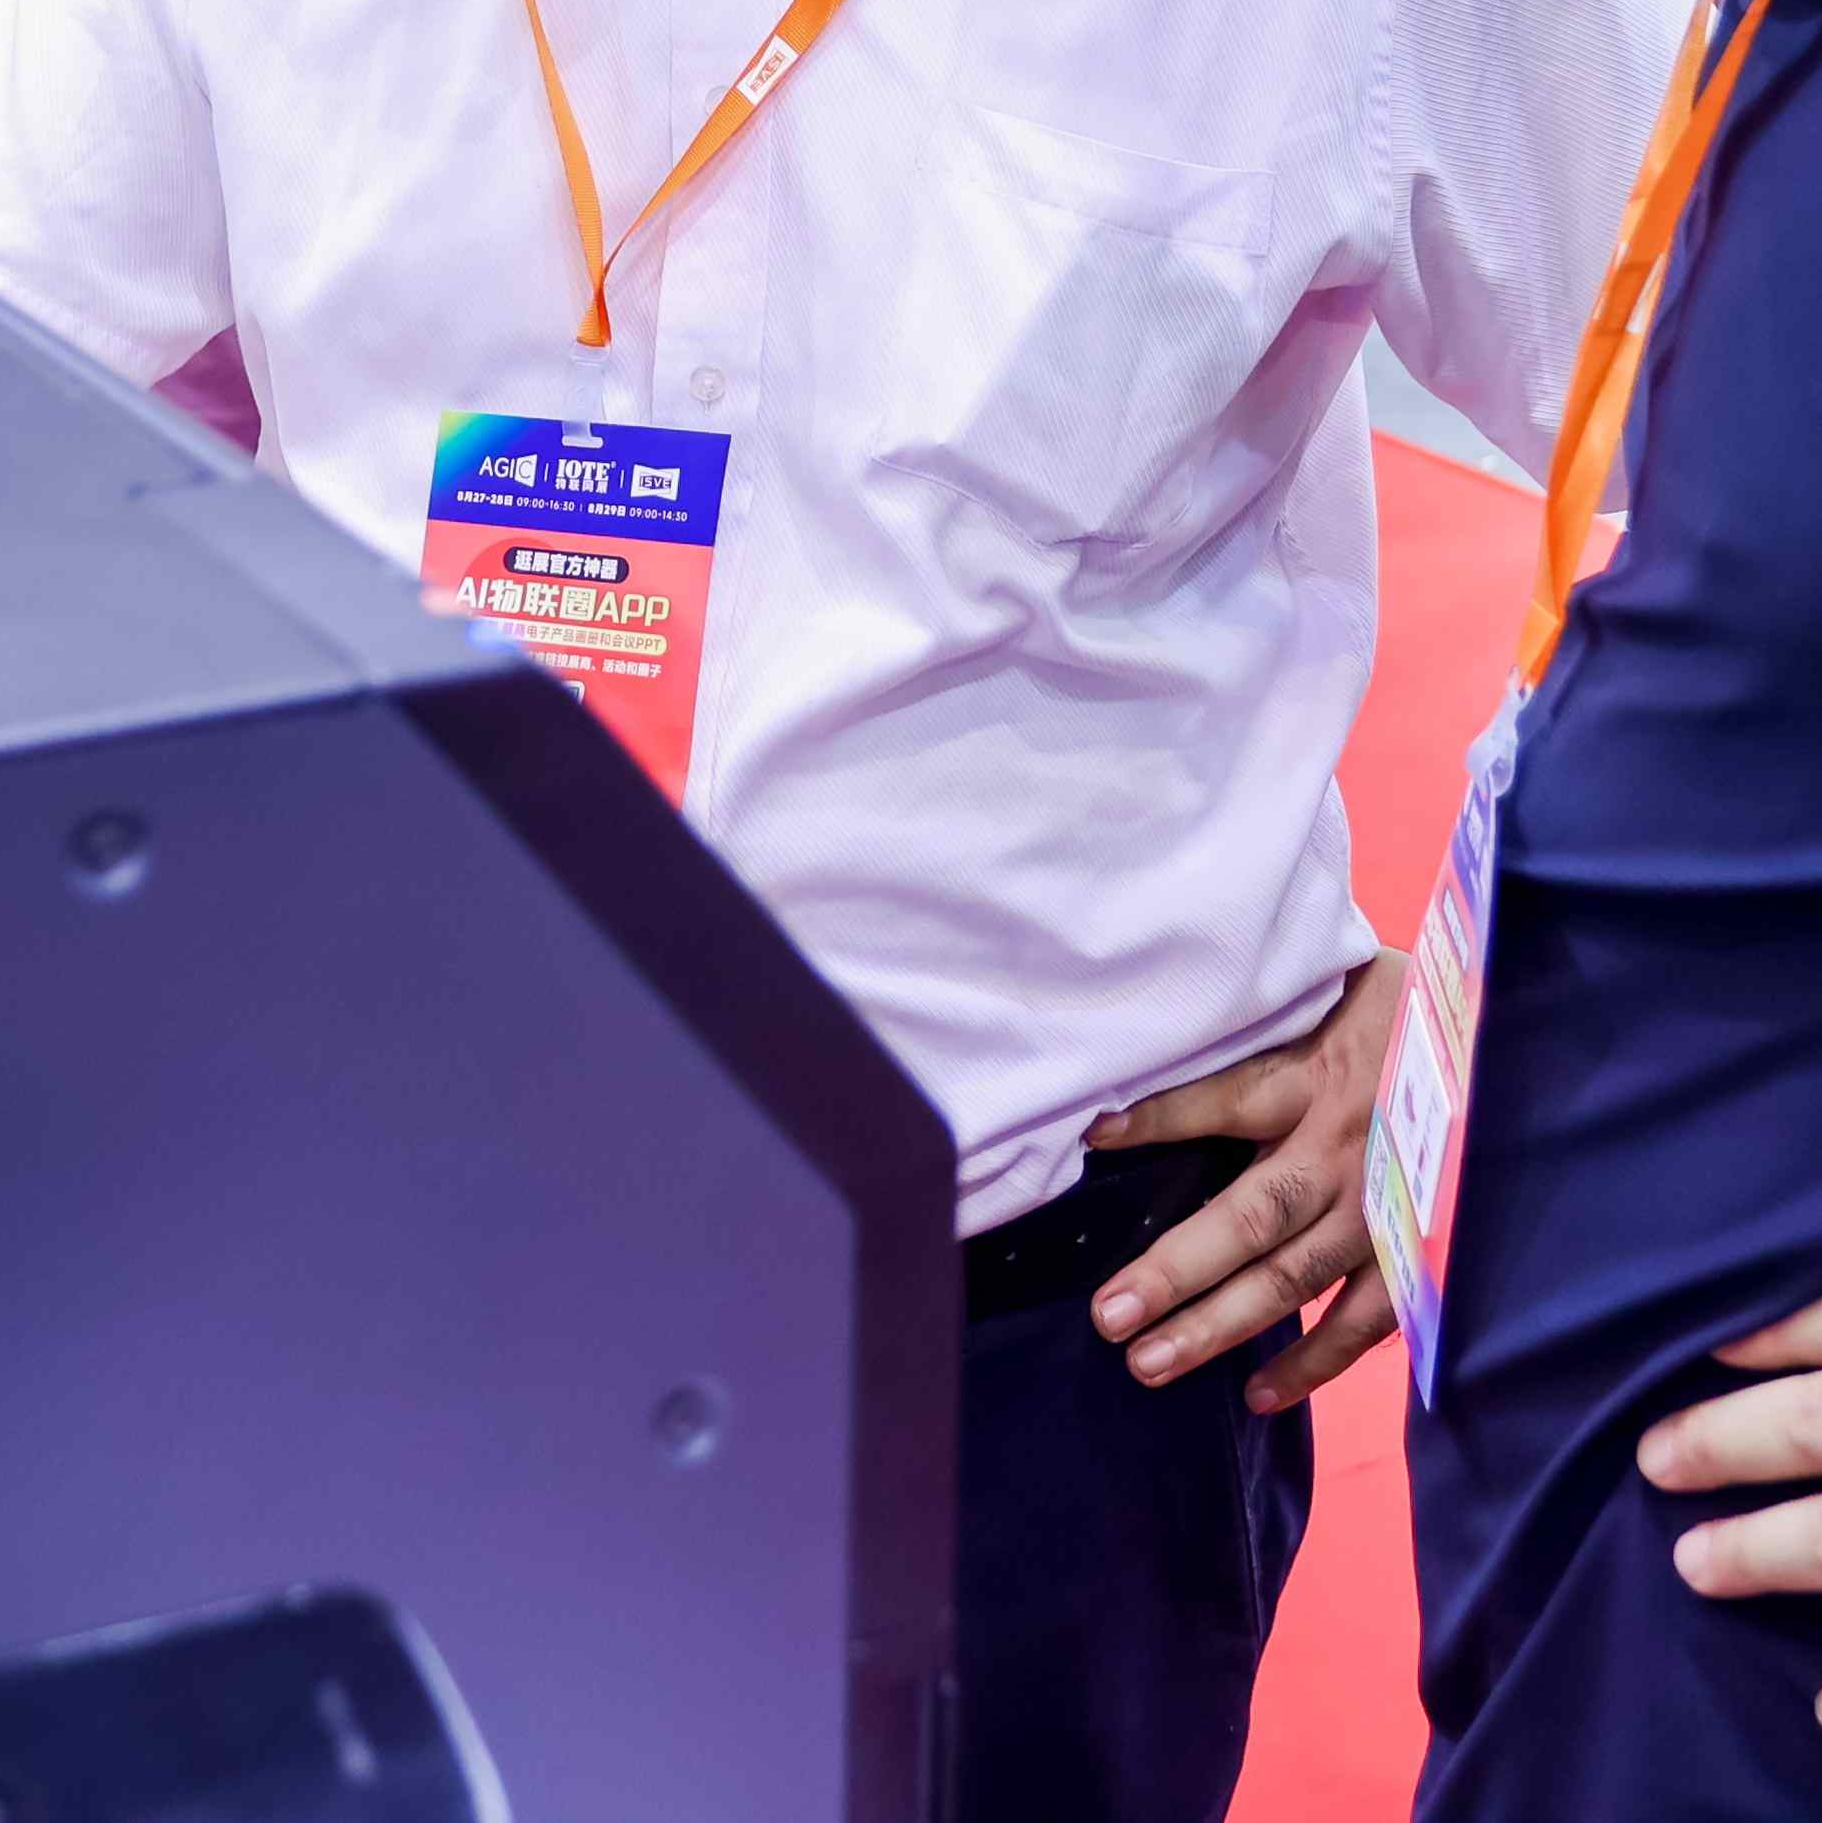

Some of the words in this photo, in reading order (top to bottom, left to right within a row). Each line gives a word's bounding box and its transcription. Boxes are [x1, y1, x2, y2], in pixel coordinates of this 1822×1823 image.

[479, 455, 538, 487] AGIC
[557, 459, 610, 482] IOTE
[555, 478, 609, 494] 物联网展
[456, 490, 514, 507] 8月27-28日
[588, 503, 626, 517] 8月29日
[513, 550, 618, 580] 逛展官方神器
[456, 576, 671, 627] AI物联圈APP
